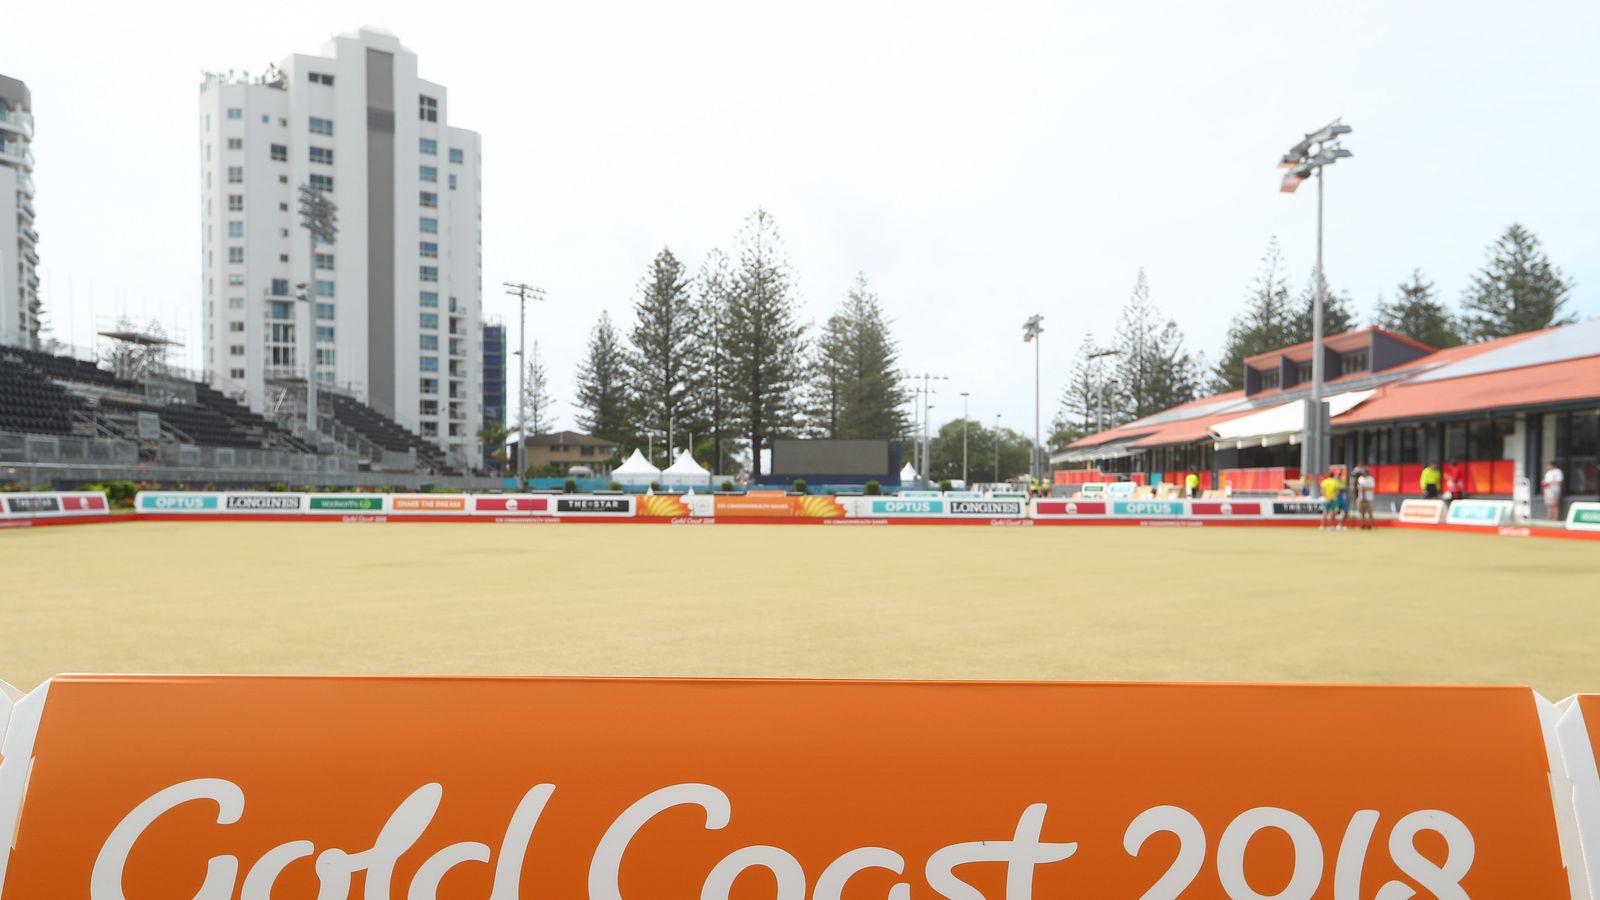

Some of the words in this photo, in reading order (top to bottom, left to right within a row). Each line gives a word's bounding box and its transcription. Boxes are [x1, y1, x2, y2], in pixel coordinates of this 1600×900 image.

[156, 497, 203, 508] OPTUS
[229, 497, 298, 508] LONGINES
[397, 500, 419, 508] SHARE
[421, 500, 433, 508] THE
[435, 500, 461, 508] DREAM
[568, 500, 587, 508] THE
[593, 500, 619, 508] STAR
[885, 502, 930, 512] OPTUS
[952, 502, 1019, 513] LONGINES
[1126, 503, 1171, 513] OPTUS
[90, 778, 556, 900] Gold
[588, 783, 1077, 900] Coast
[1123, 805, 1476, 900] 2018
